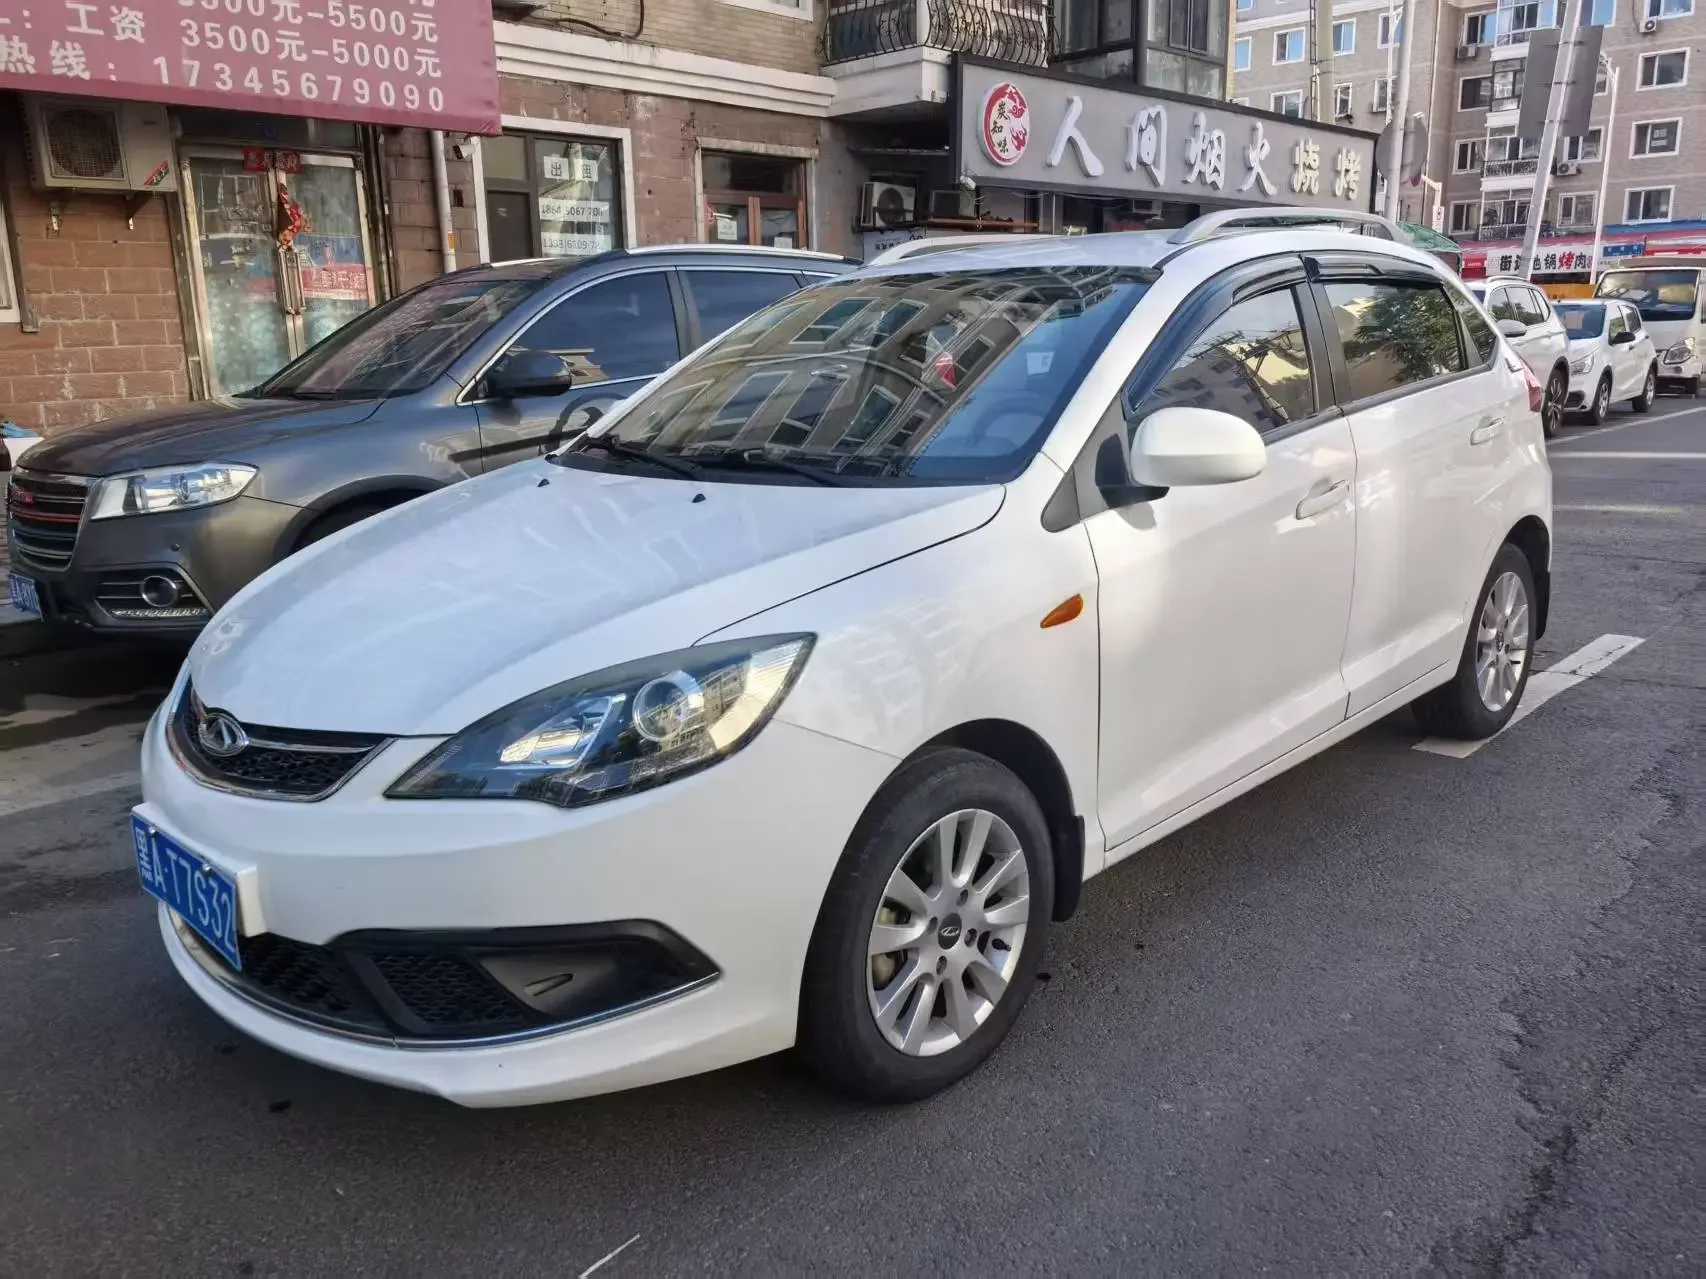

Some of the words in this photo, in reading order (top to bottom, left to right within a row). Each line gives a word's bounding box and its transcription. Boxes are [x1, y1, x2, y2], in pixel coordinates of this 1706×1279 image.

[64, 1, 145, 44] 工资
[179, 19, 442, 78] 3500元-5000元
[153, 56, 444, 112] 17345679090
